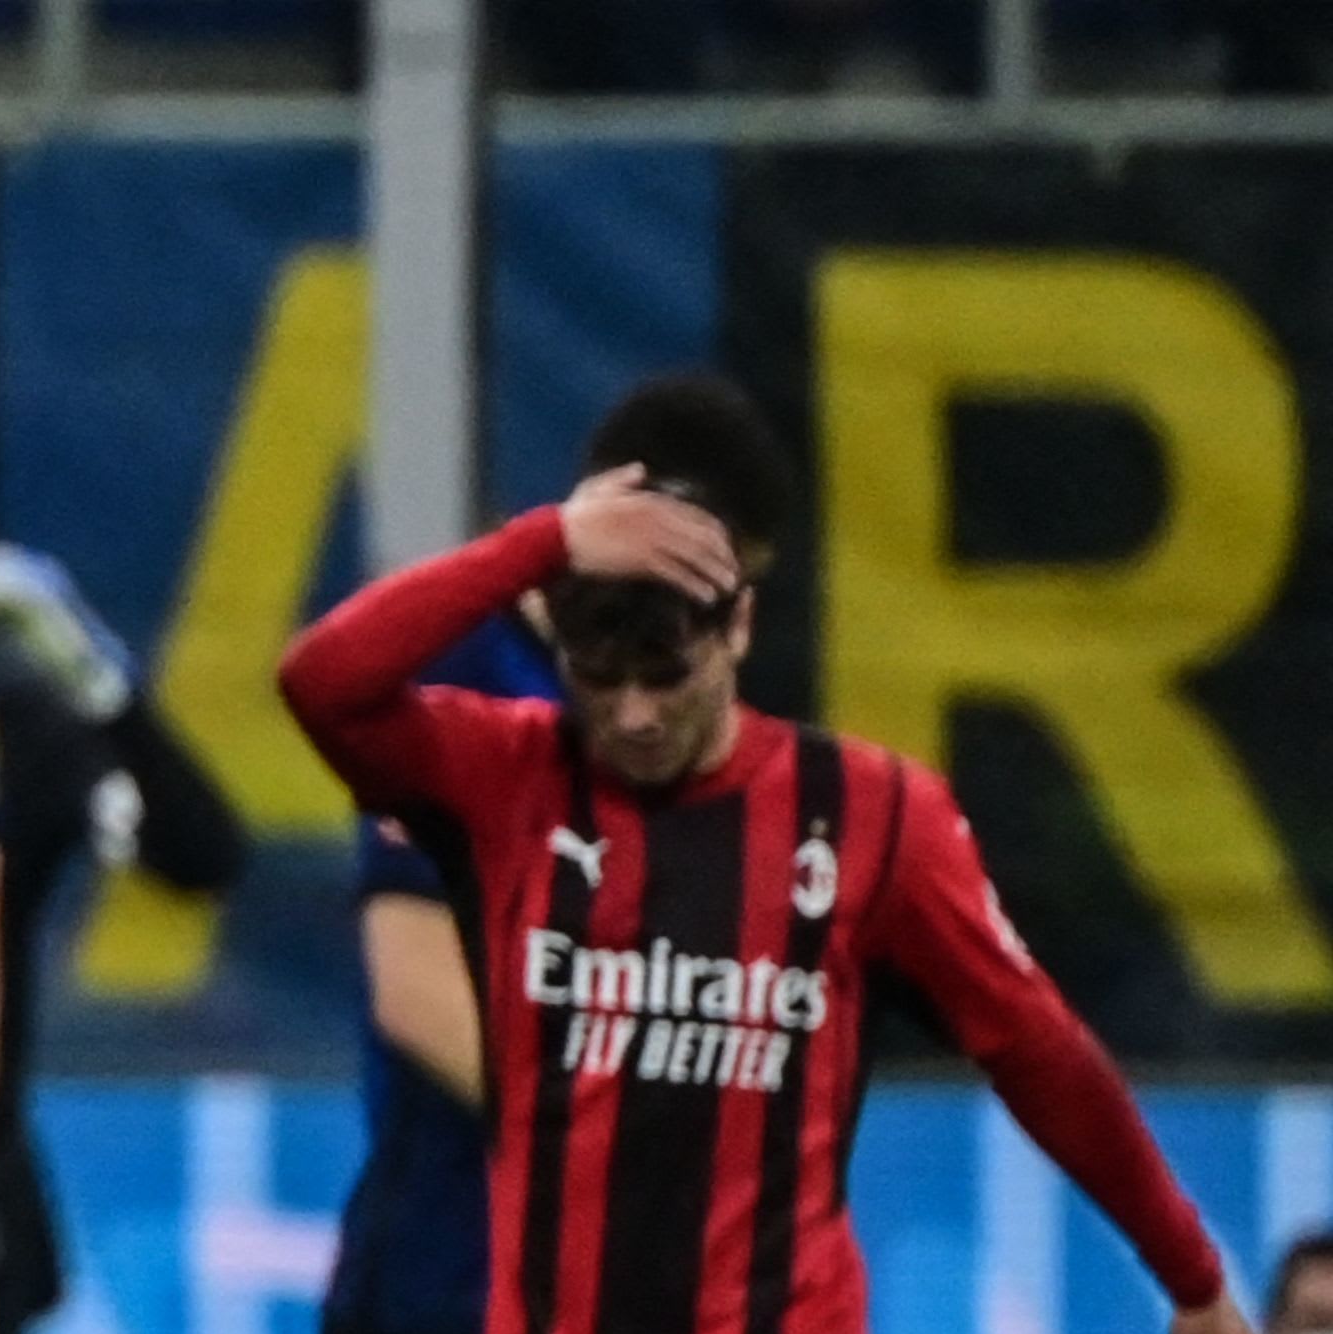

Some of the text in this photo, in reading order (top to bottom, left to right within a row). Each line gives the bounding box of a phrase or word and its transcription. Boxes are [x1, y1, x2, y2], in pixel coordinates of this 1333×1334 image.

[524, 926, 829, 1032] Emirates
[561, 1011, 791, 1092] FLY BETTER
